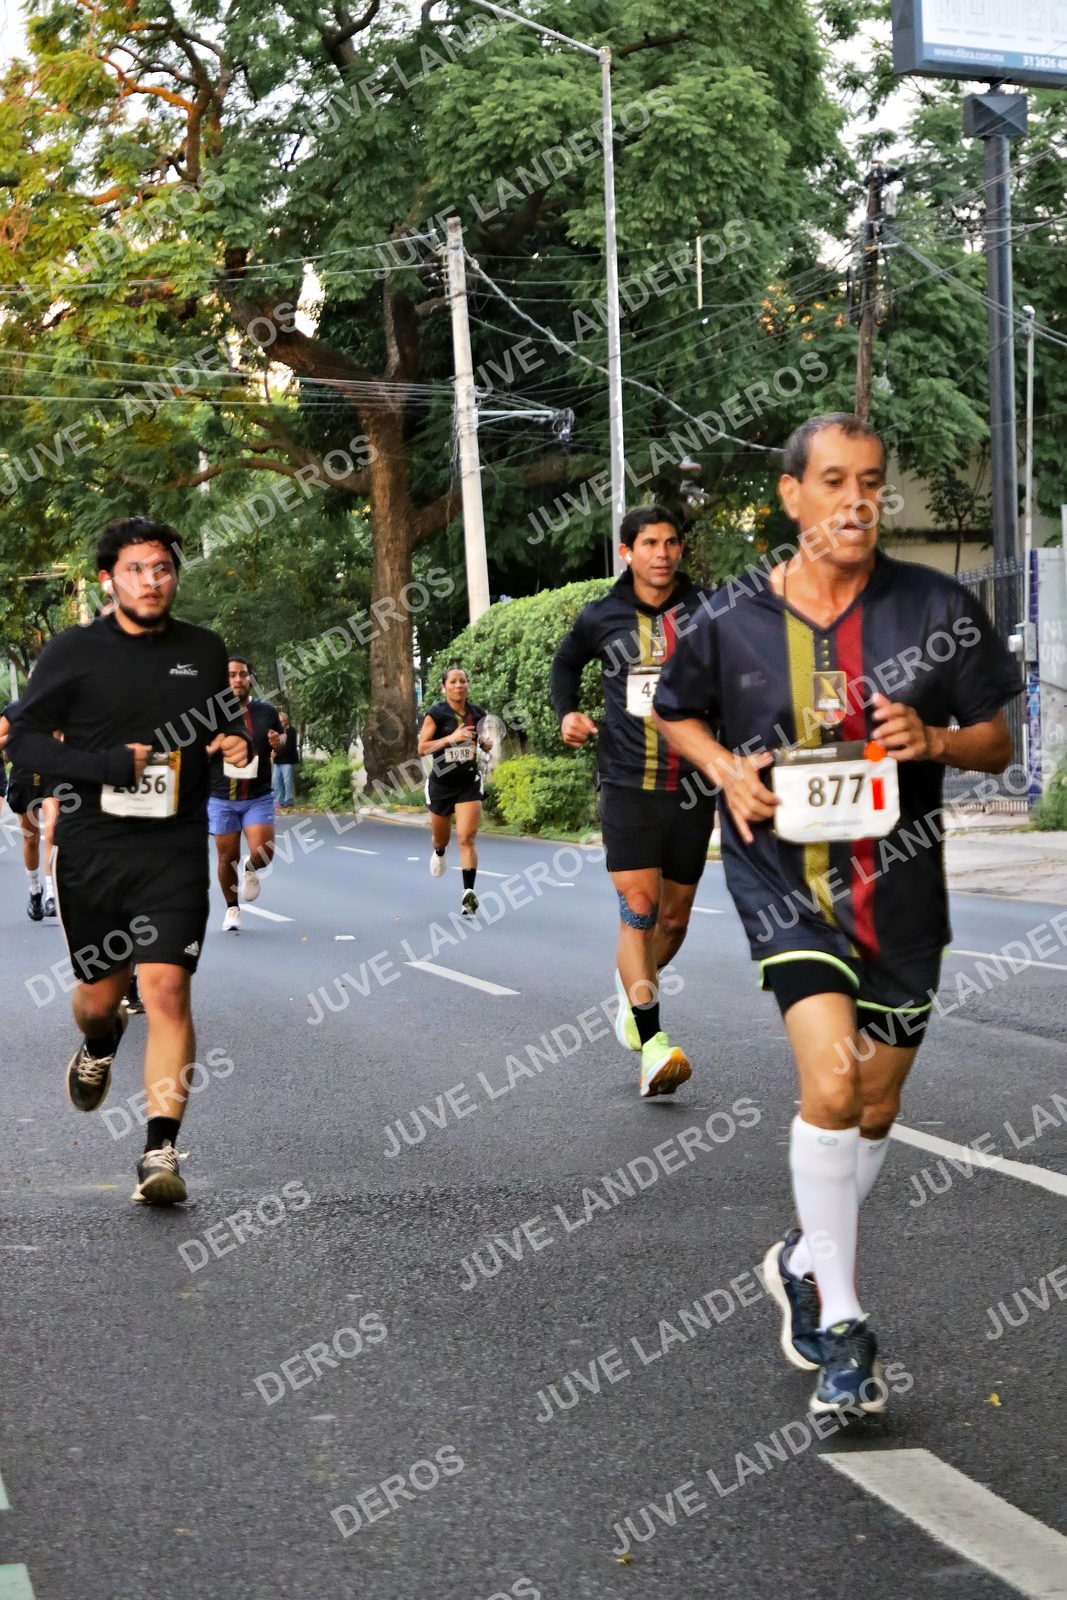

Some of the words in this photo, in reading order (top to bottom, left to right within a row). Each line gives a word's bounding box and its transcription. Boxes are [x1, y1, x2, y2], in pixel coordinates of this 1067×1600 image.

[641, 681, 658, 697] 4
[113, 774, 167, 794] 56
[807, 766, 866, 807] 877
